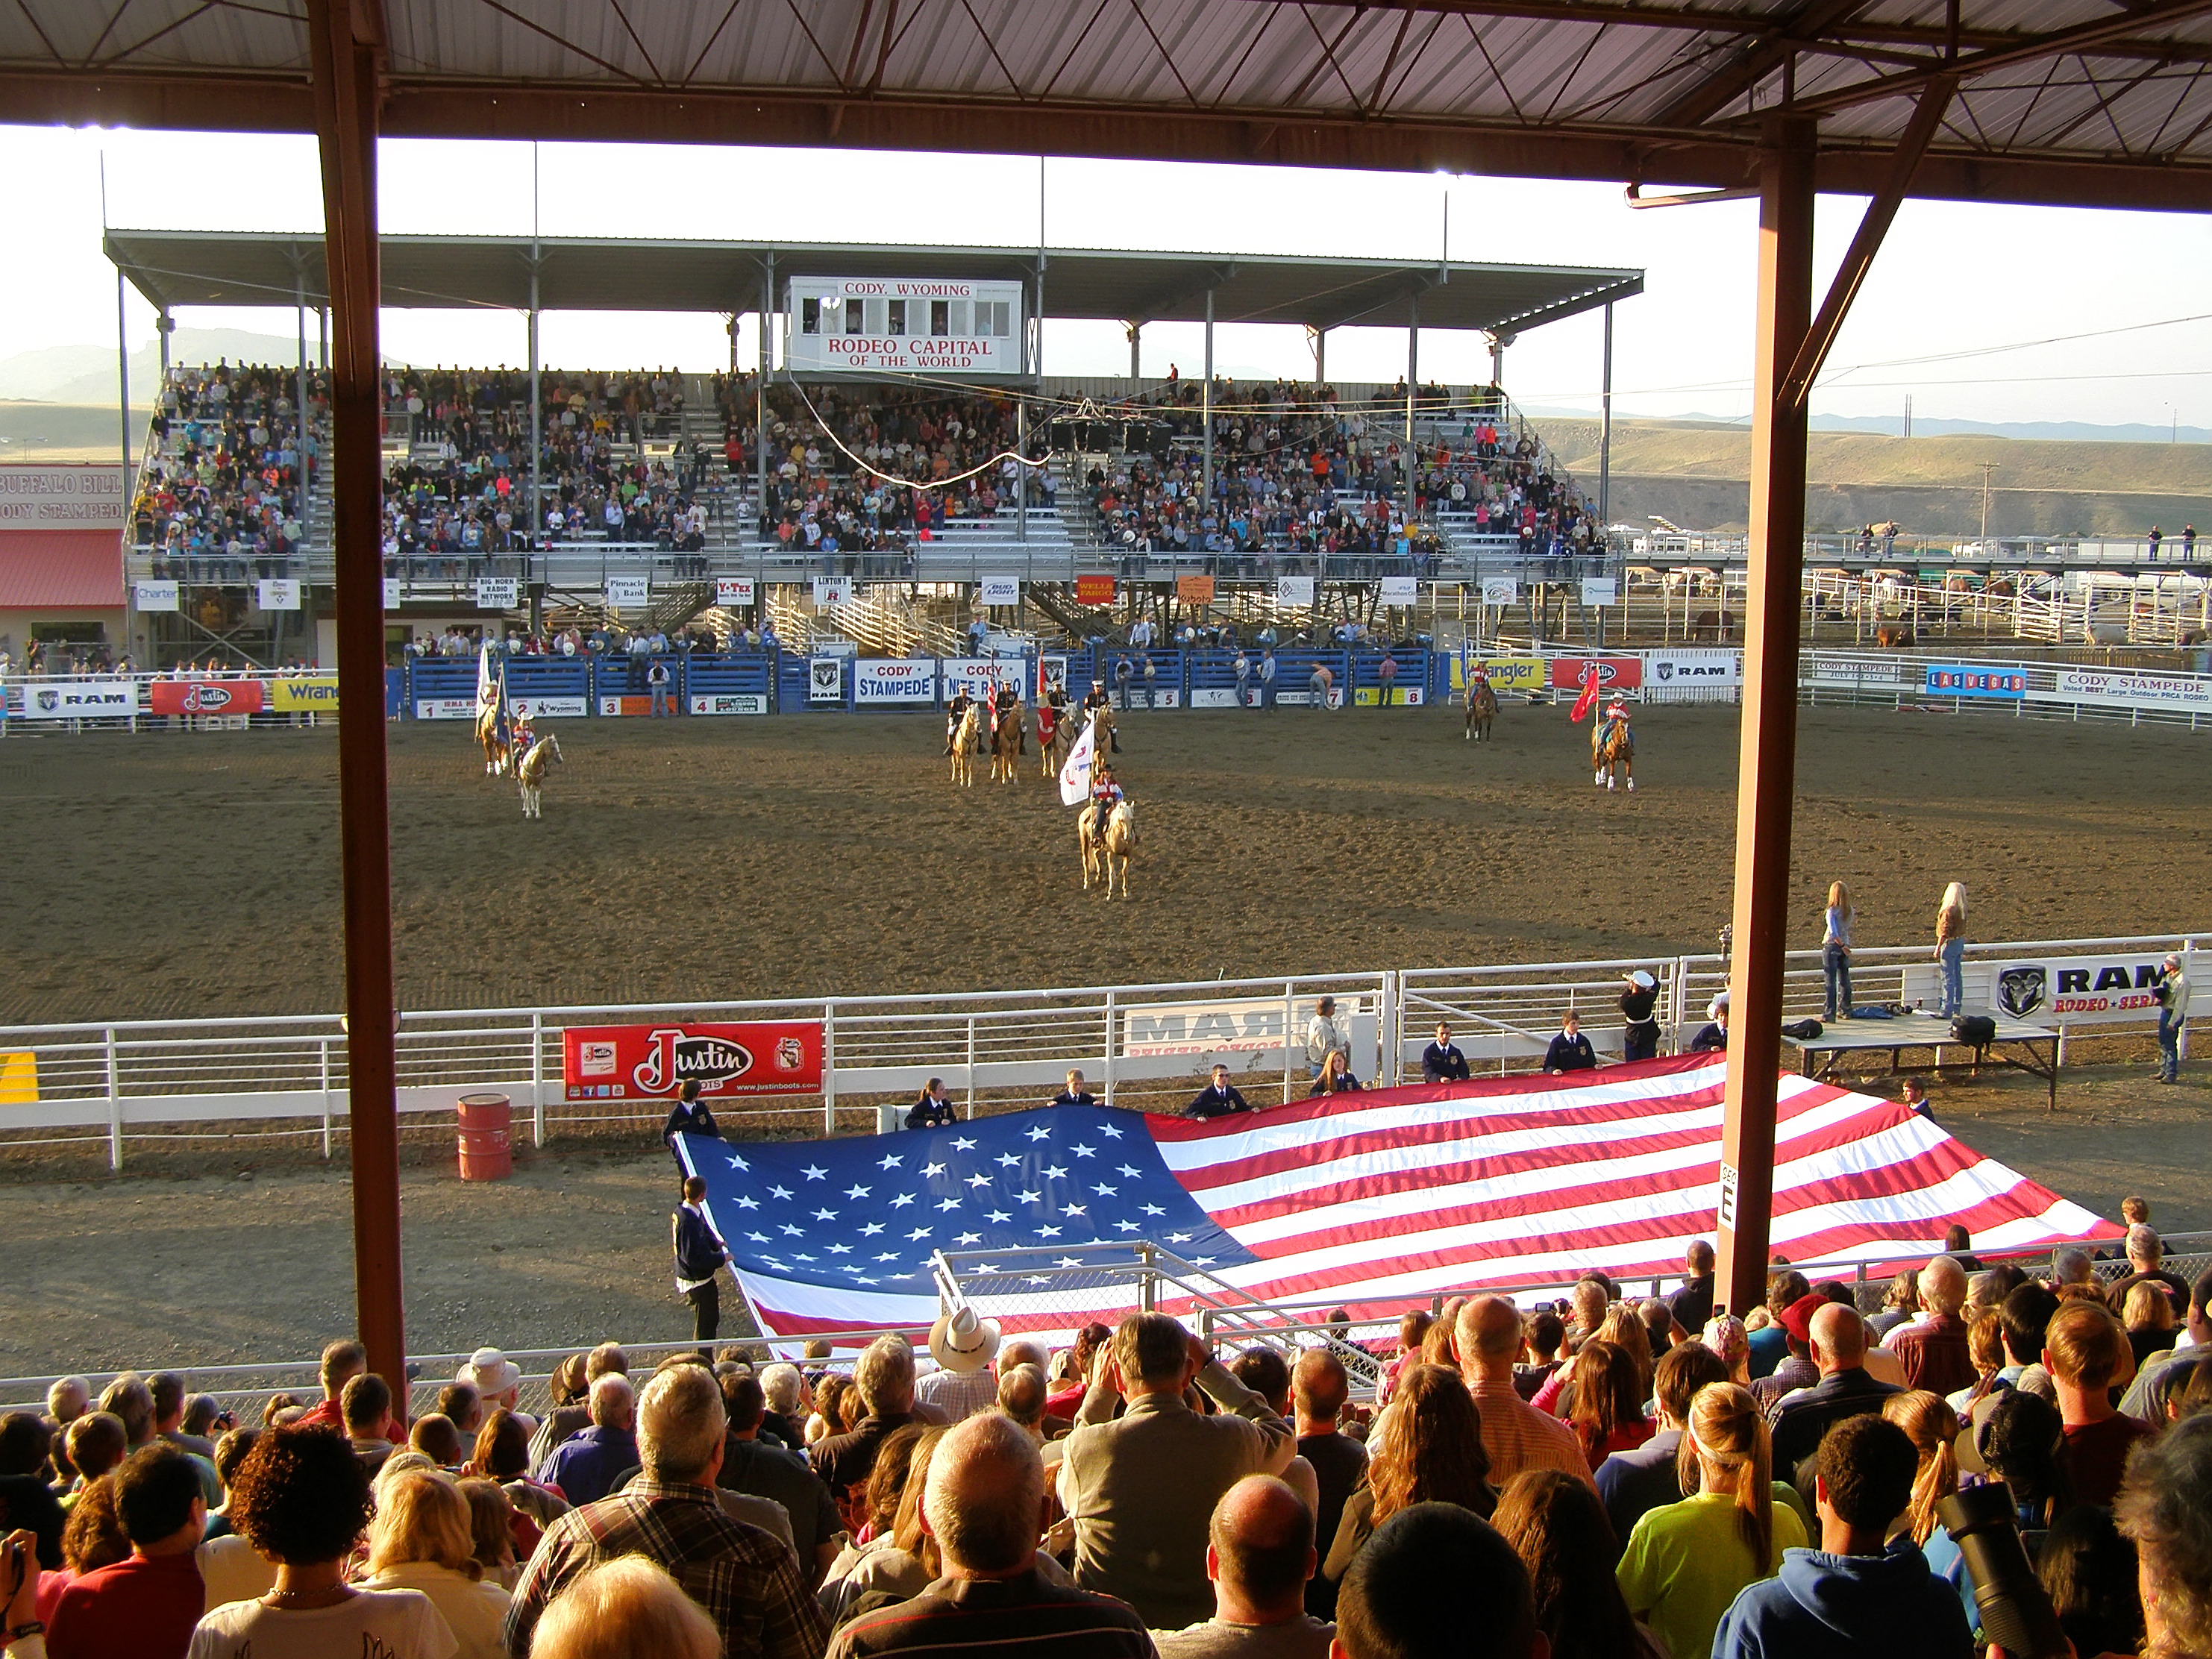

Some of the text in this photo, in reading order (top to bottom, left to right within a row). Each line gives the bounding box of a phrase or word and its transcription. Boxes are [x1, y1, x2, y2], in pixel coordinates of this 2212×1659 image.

[845, 282, 971, 296] CODY, WYOMING
[828, 339, 993, 355] RODEO CAPITAL
[849, 354, 971, 367] OF THE WORLD
[0, 474, 122, 494] BUFFALO BILL
[610, 579, 645, 587] Pinnacle
[818, 577, 847, 586] LINTON'S
[138, 588, 178, 598] Charter
[1178, 594, 1212, 603] Kubota
[877, 665, 913, 676] CODY
[1679, 665, 1726, 675] RAM
[1819, 662, 1843, 670] CODY
[1931, 671, 2021, 689] LAS VEGAS
[2067, 674, 2206, 694] CODY STAMPEDE
[859, 677, 930, 697] STAMPEDE
[66, 694, 126, 704] RAM
[184, 684, 228, 711] Justin
[1165, 694, 1173, 705] 5
[1329, 693, 1338, 703] 7
[1409, 692, 1417, 703] 8
[2107, 688, 2127, 697] Large
[2130, 689, 2158, 698] Outdoor
[2161, 691, 2180, 700] PRCA
[2183, 694, 2209, 702] RODEO
[426, 706, 433, 717] 1
[518, 703, 527, 715] 2
[606, 703, 615, 713] 3
[697, 701, 708, 712] 4
[2053, 997, 2108, 1013] RODEO
[633, 1029, 744, 1094] Justin
[736, 1082, 819, 1092] www.justinboots.com
[1722, 1166, 1737, 1185] SEC
[1722, 1185, 1733, 1223] E
